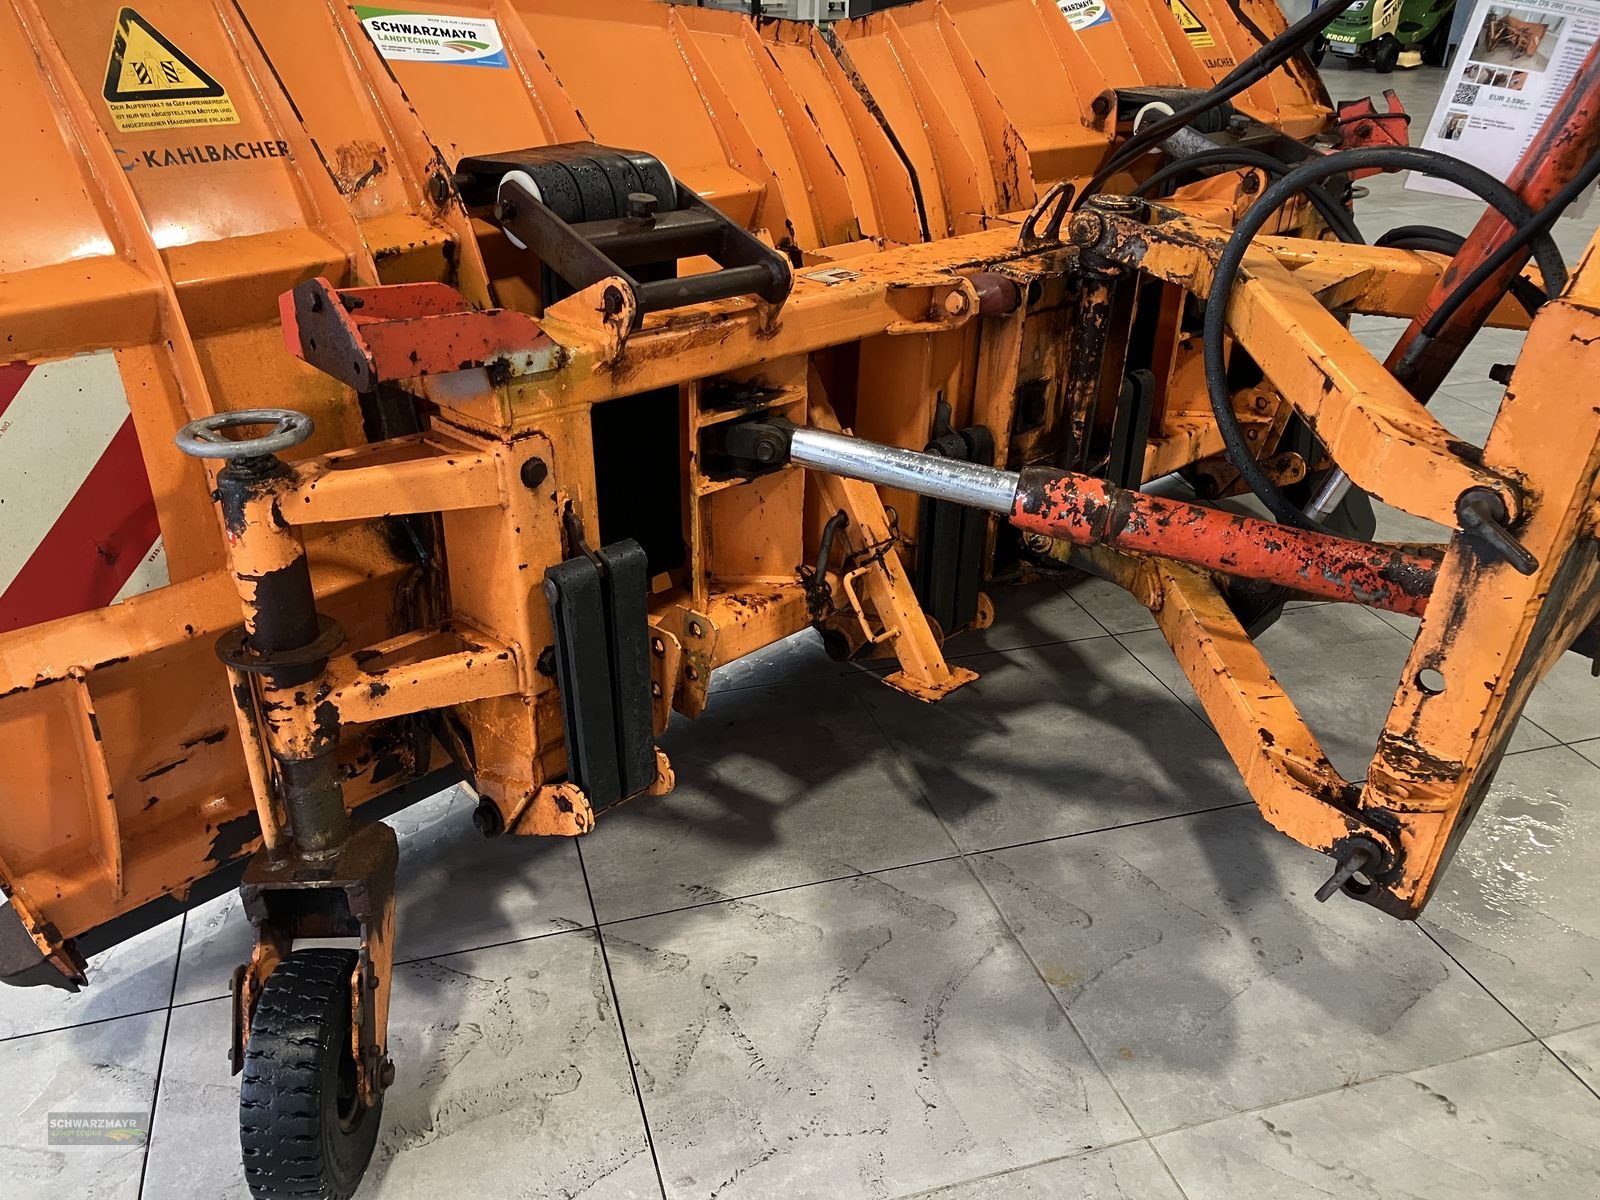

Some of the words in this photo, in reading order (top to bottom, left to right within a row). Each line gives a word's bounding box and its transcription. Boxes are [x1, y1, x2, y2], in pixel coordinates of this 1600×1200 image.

[371, 20, 477, 40] SCHWARZMAYR
[377, 33, 441, 46] LANDTECHNIK
[1326, 32, 1356, 43] KRONE
[1488, 93, 1505, 102] EUR
[121, 120, 167, 129] ANGEZOGENER
[166, 118, 208, 126] HANDBREMSE
[142, 140, 289, 168] KAHLBACHER
